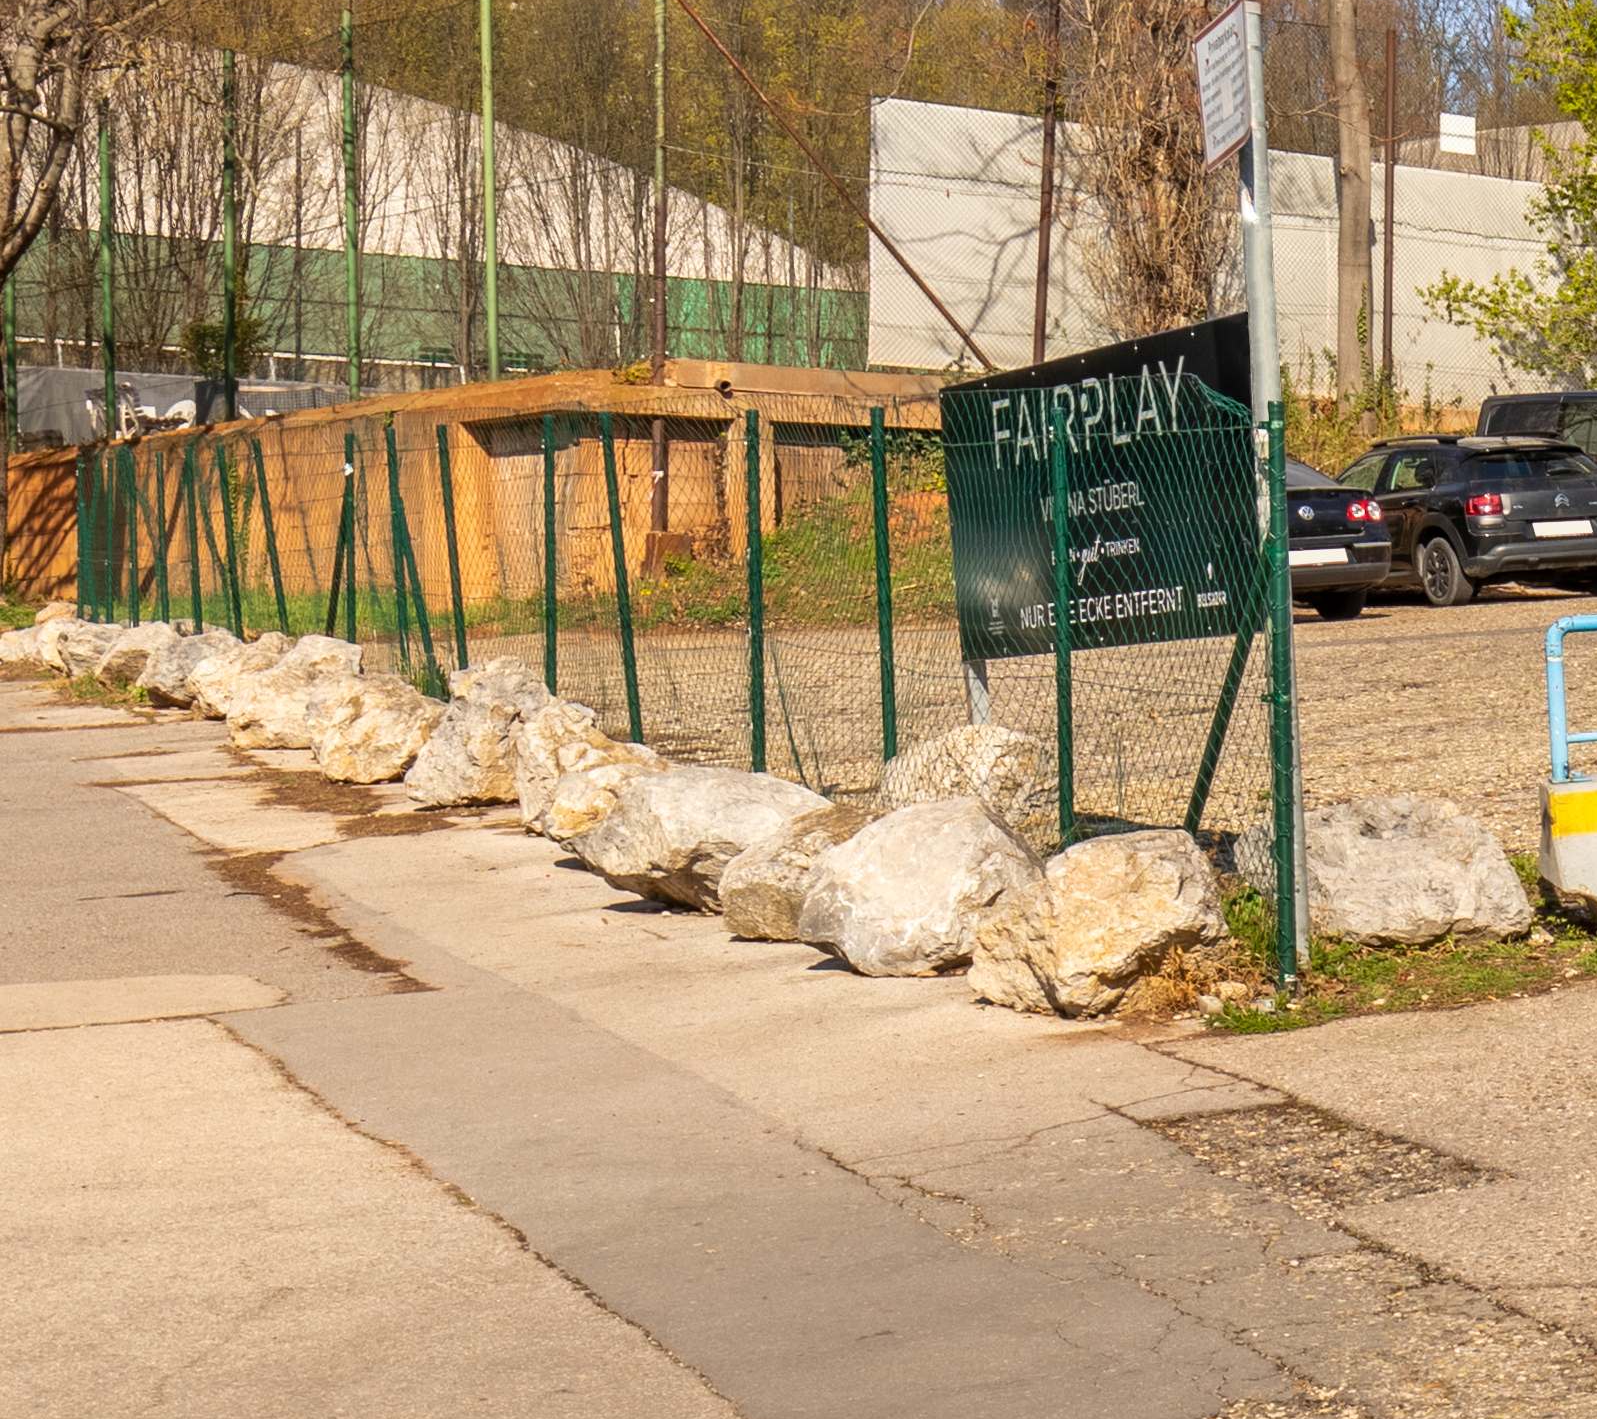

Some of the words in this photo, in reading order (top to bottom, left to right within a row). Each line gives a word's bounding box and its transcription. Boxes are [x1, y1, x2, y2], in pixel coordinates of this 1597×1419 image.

[992, 356, 1185, 469] FAIRPLAY
[1040, 490, 1087, 522] VINA
[1088, 479, 1145, 515] STÜBERL
[1105, 537, 1140, 558] TRINKEN
[1020, 603, 1046, 630] NUR
[1048, 600, 1077, 626] EE
[1079, 594, 1113, 623] ECKE
[1115, 586, 1184, 619] ENTFERNT
